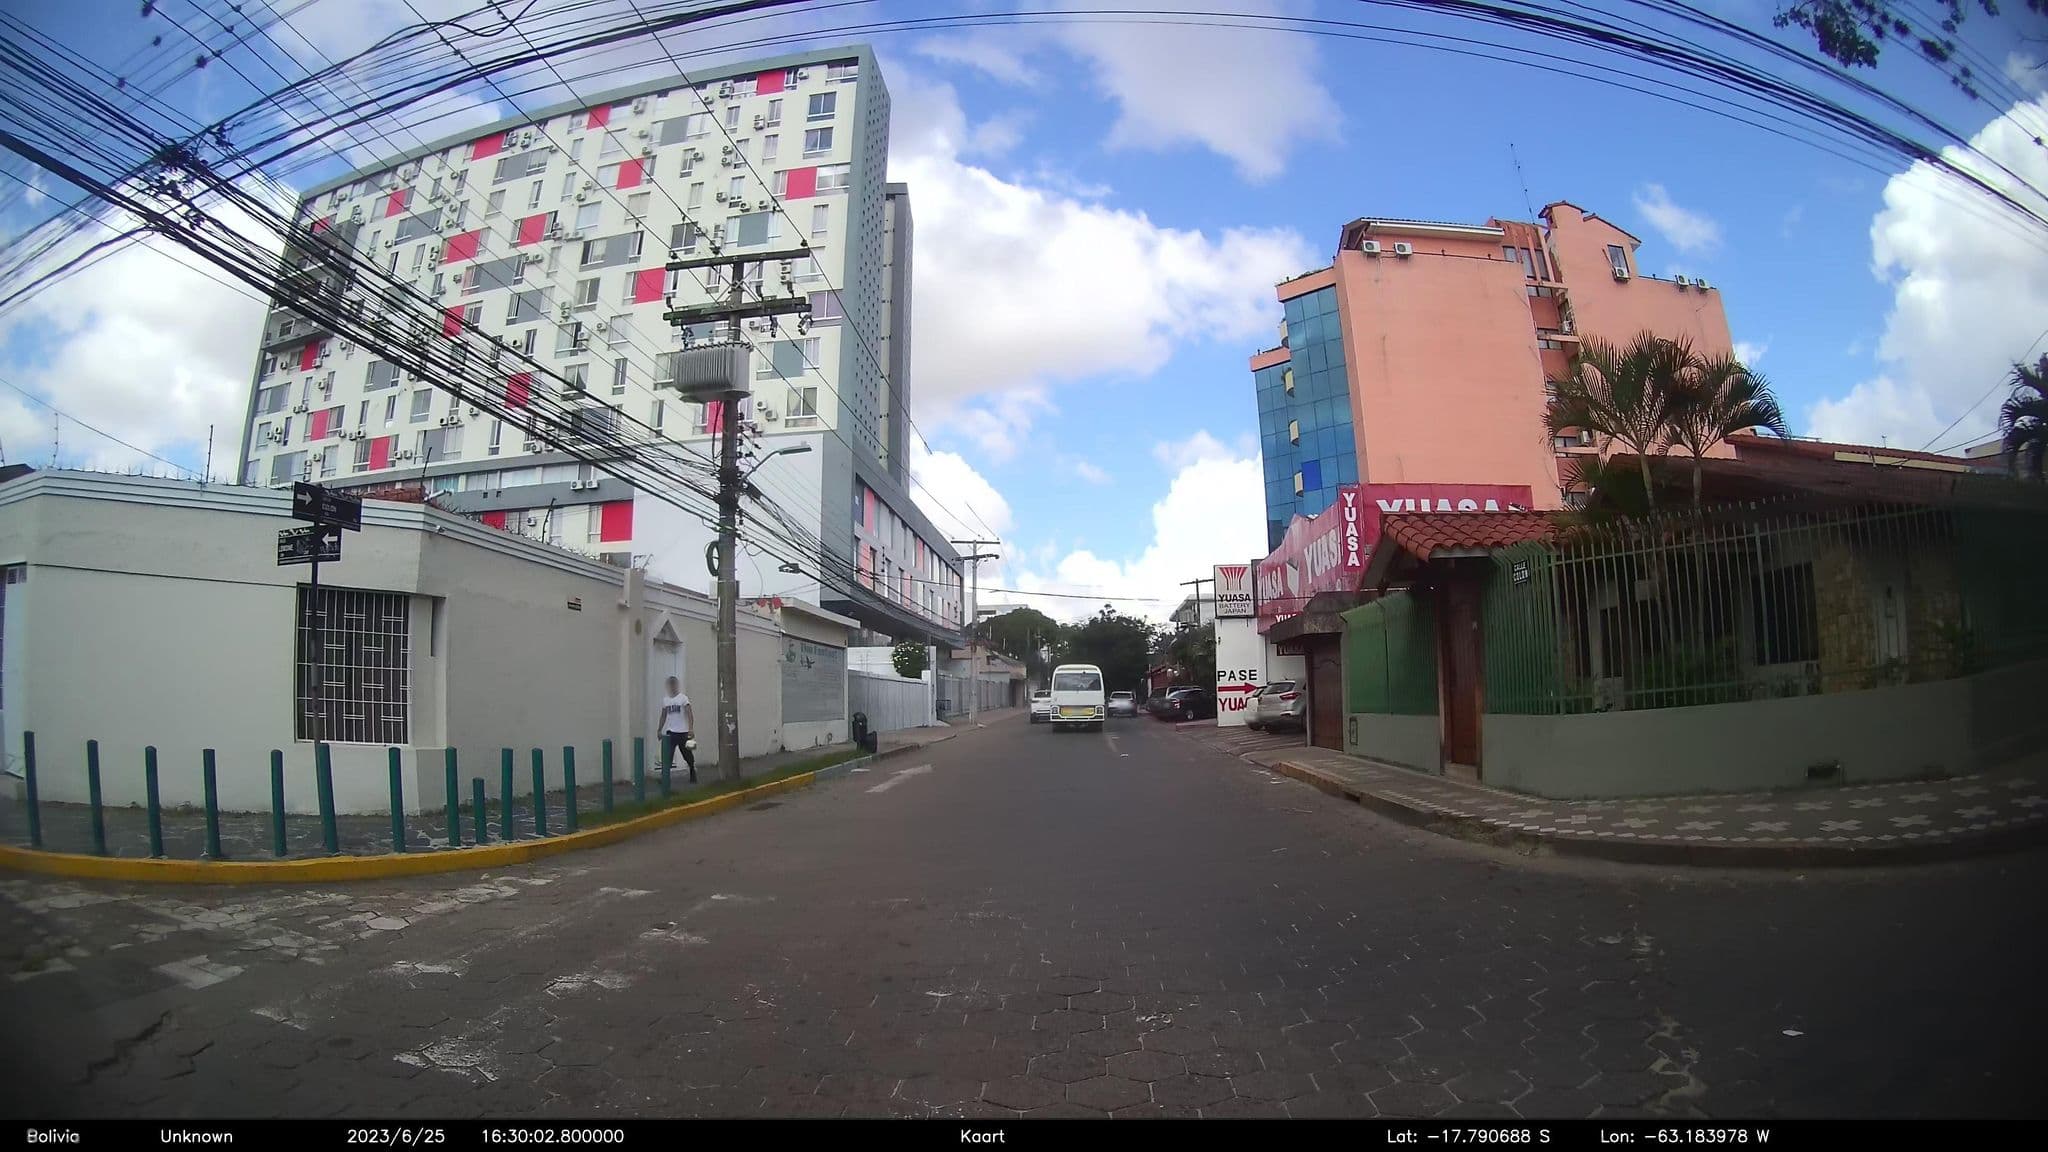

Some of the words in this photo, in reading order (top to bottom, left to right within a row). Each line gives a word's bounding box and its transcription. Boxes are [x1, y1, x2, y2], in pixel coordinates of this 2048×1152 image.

[1343, 492, 1361, 567] YUASA
[1218, 594, 1251, 602] YUASA
[1217, 670, 1257, 681] PASE
[1218, 697, 1250, 712] YUA
